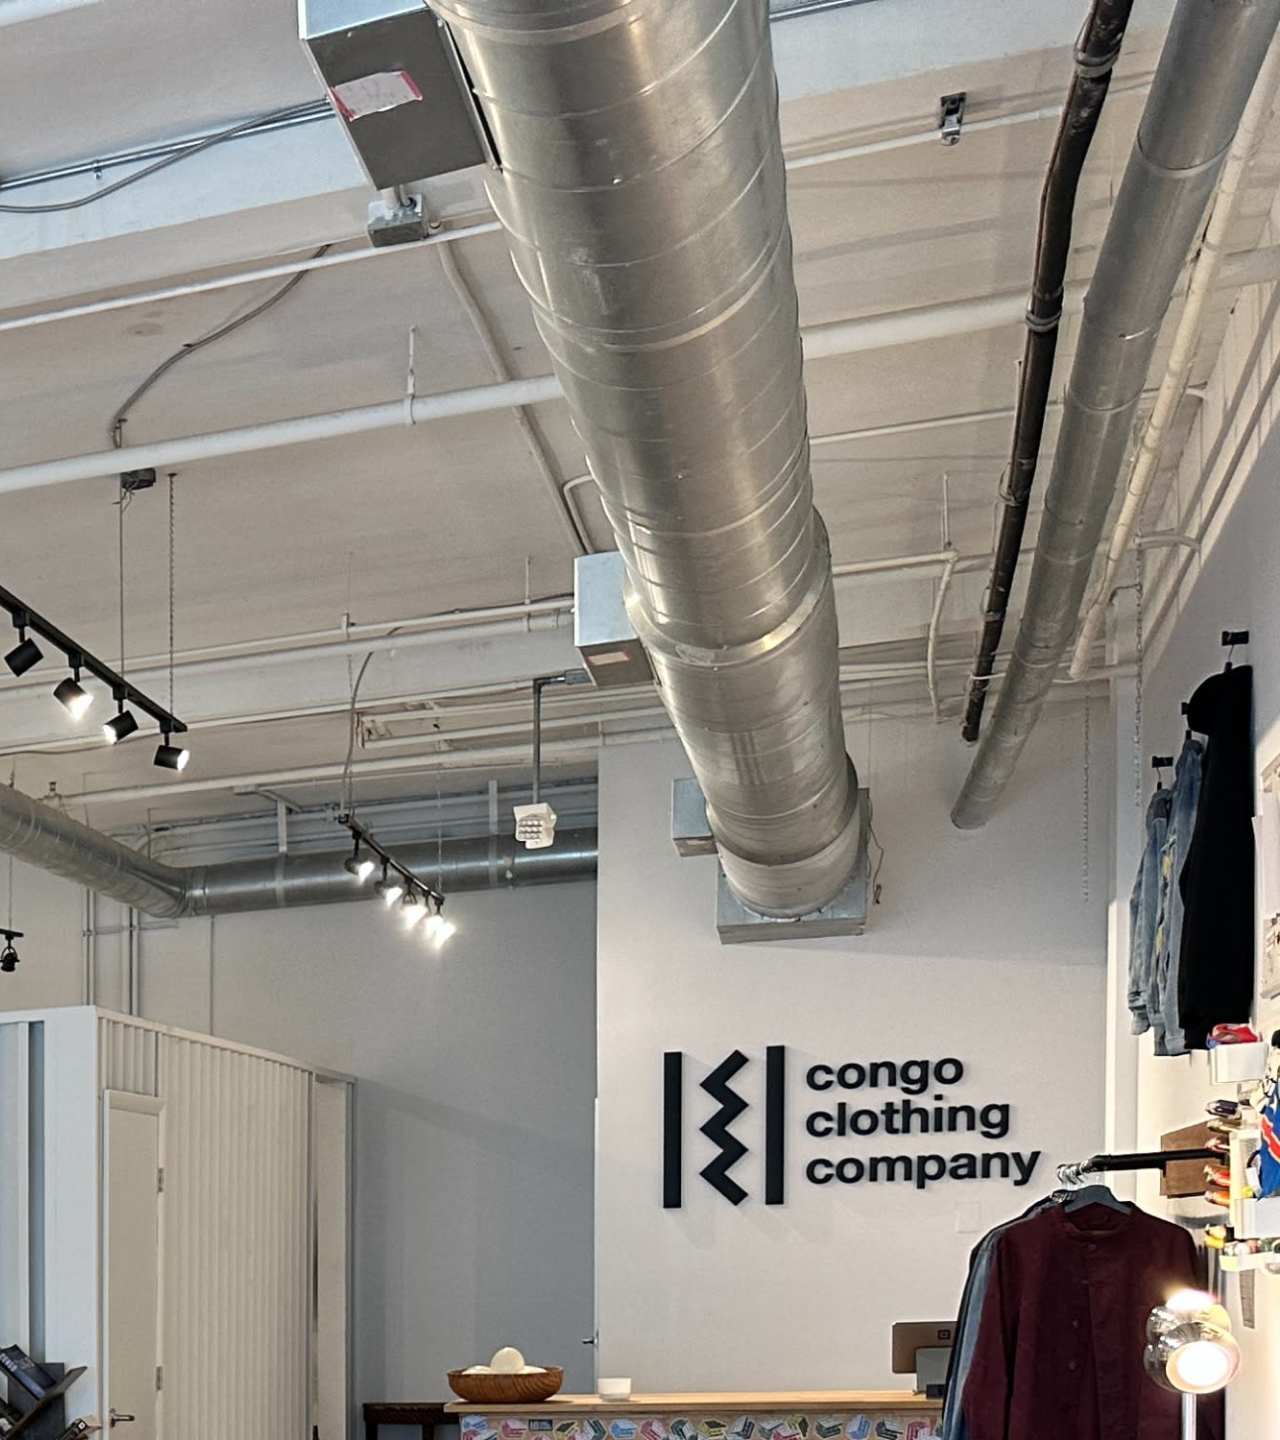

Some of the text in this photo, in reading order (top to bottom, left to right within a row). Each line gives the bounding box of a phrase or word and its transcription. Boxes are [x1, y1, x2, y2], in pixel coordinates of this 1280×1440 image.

[805, 1057, 964, 1096] congo
[805, 1093, 1010, 1140] clothing
[805, 1150, 1042, 1190] company
